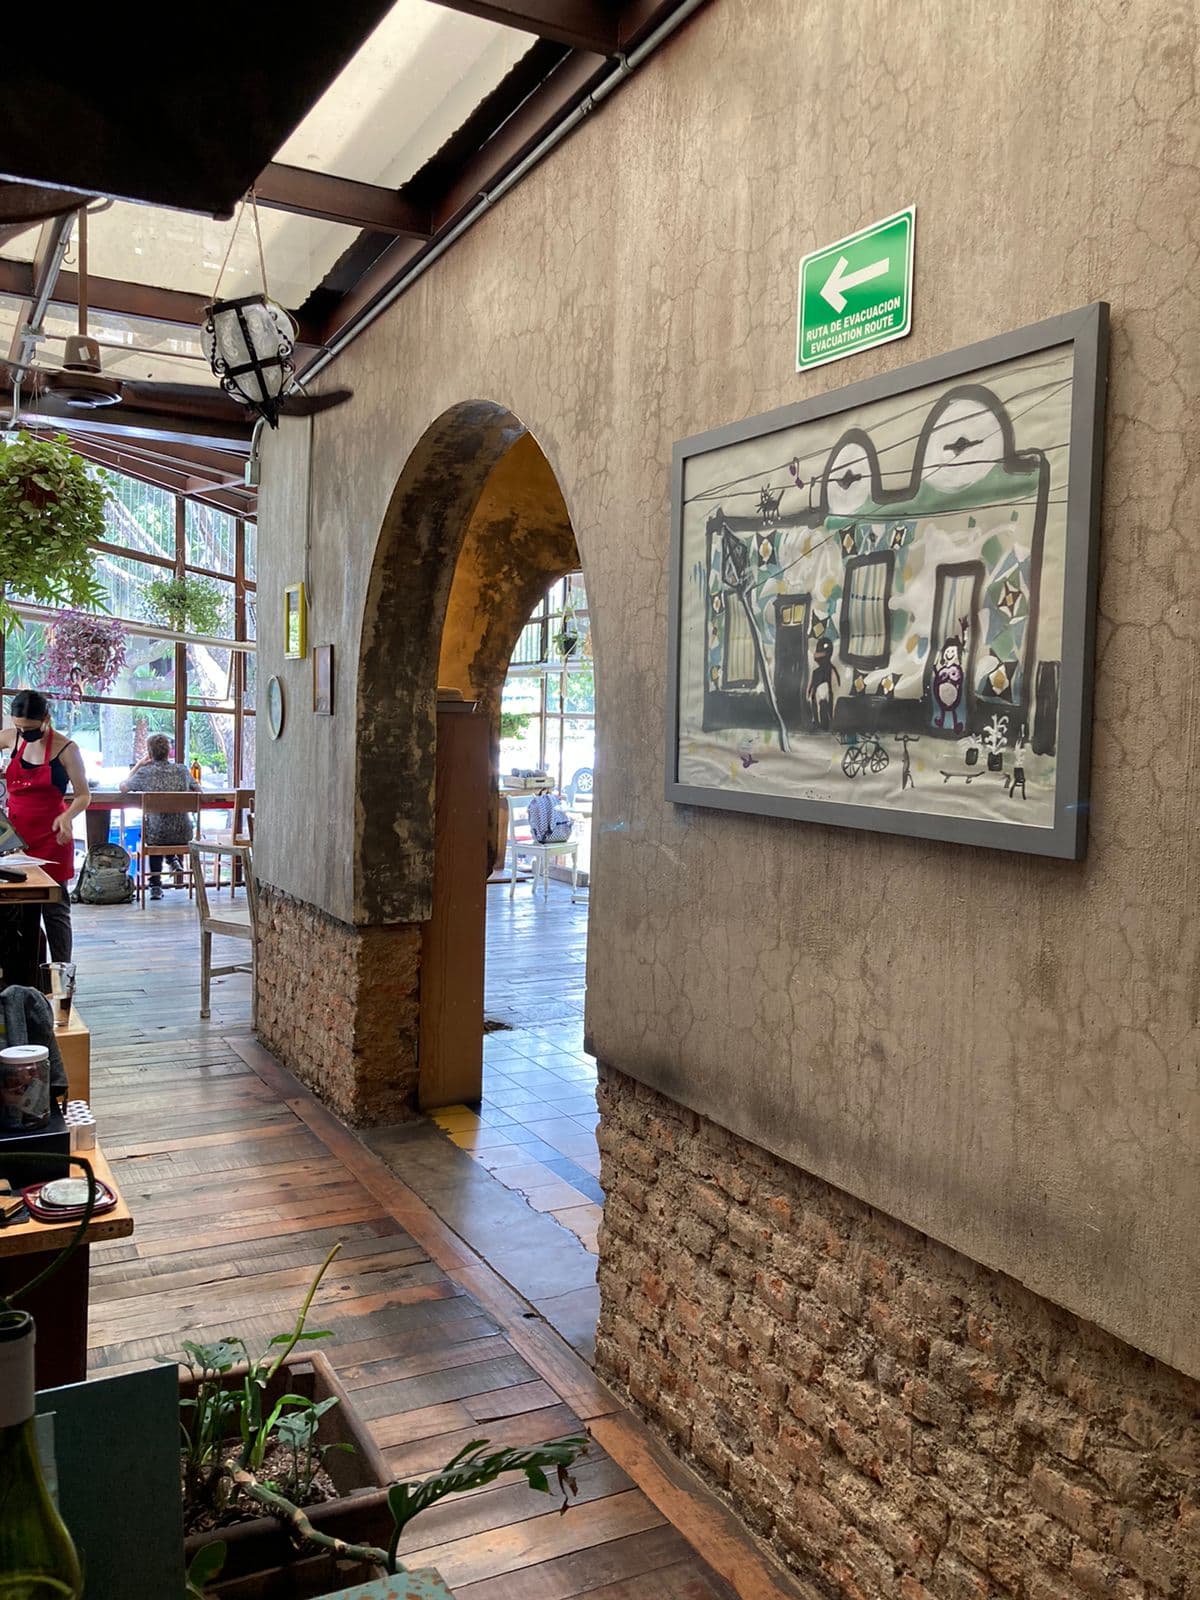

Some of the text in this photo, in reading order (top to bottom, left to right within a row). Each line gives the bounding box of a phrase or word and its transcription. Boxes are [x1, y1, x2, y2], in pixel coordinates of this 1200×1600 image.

[806, 296, 901, 341] RUTA DE EVACUACION
[811, 314, 894, 354] EVACUATION ROUTE
